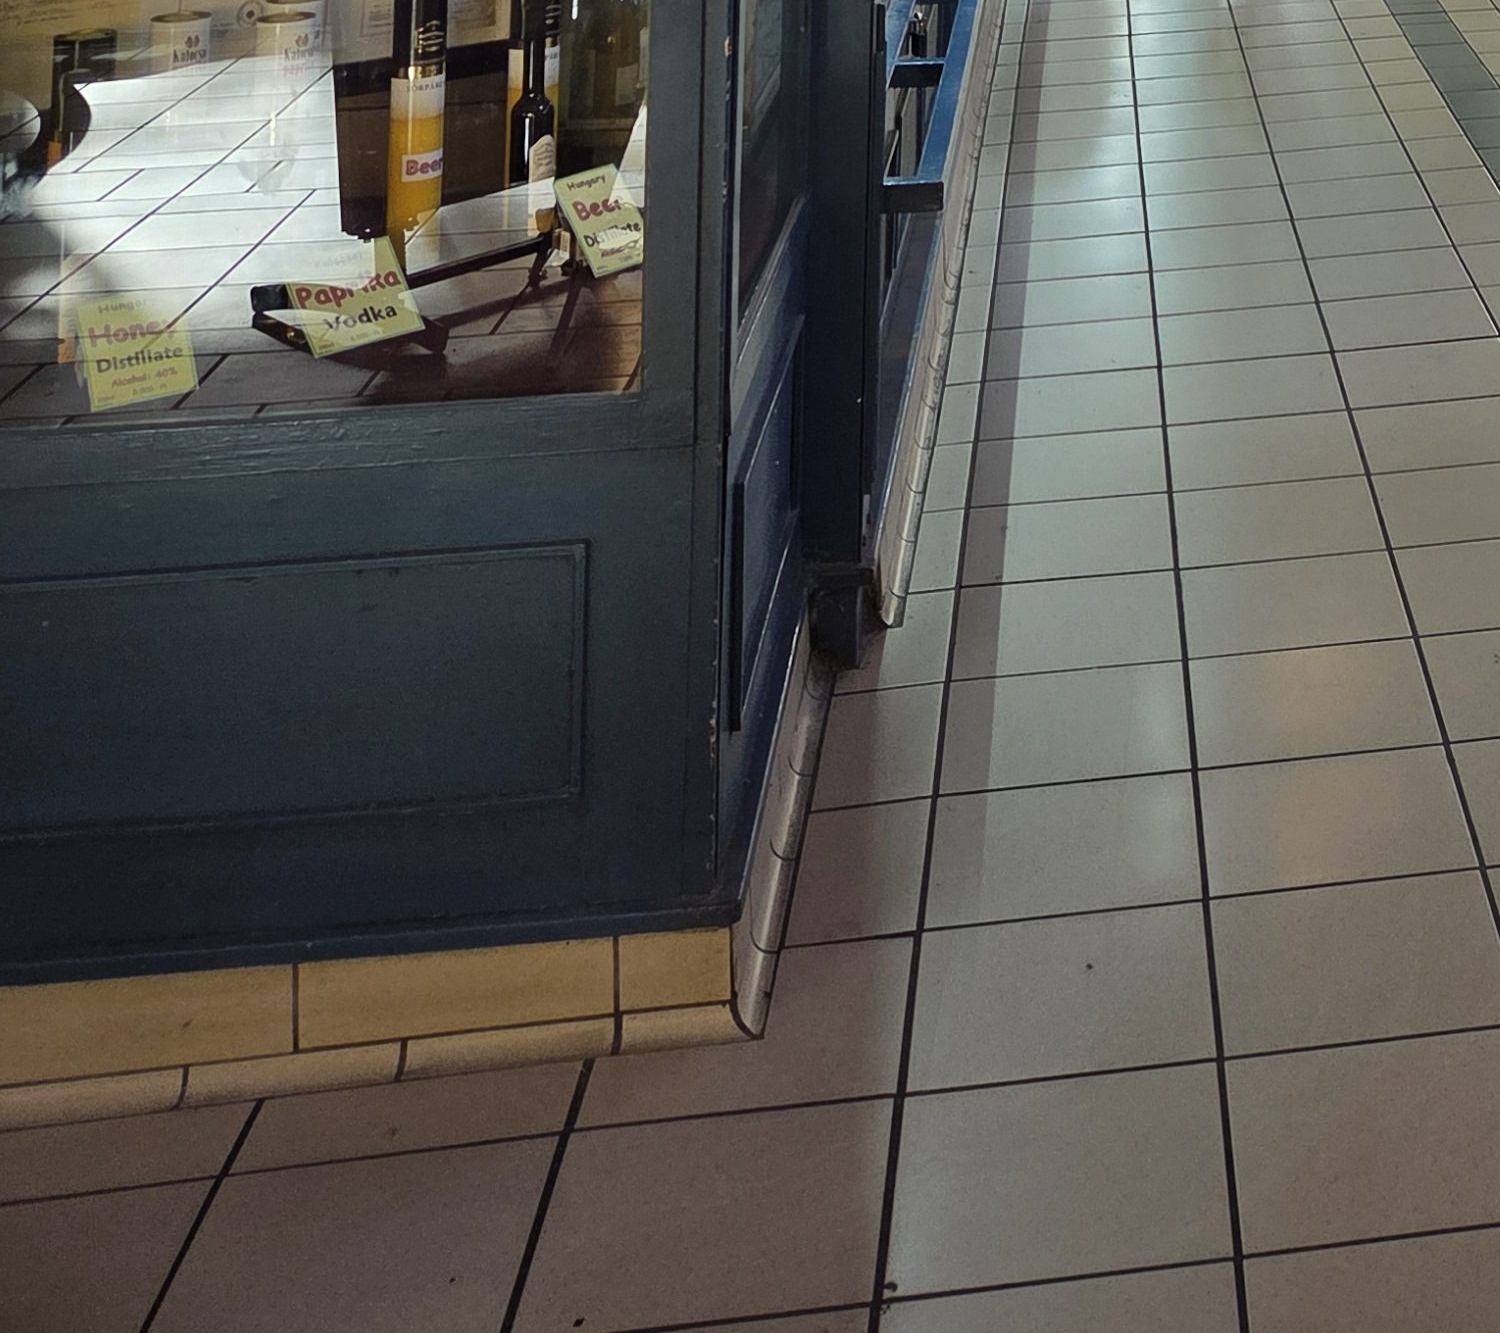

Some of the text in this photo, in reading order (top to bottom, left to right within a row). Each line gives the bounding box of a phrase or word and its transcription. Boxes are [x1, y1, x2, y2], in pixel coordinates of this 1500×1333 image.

[405, 157, 443, 177] Beer
[571, 197, 622, 222] Beer
[98, 299, 148, 314] Hunga
[323, 304, 398, 331] Vodka
[96, 346, 184, 374] Distillate
